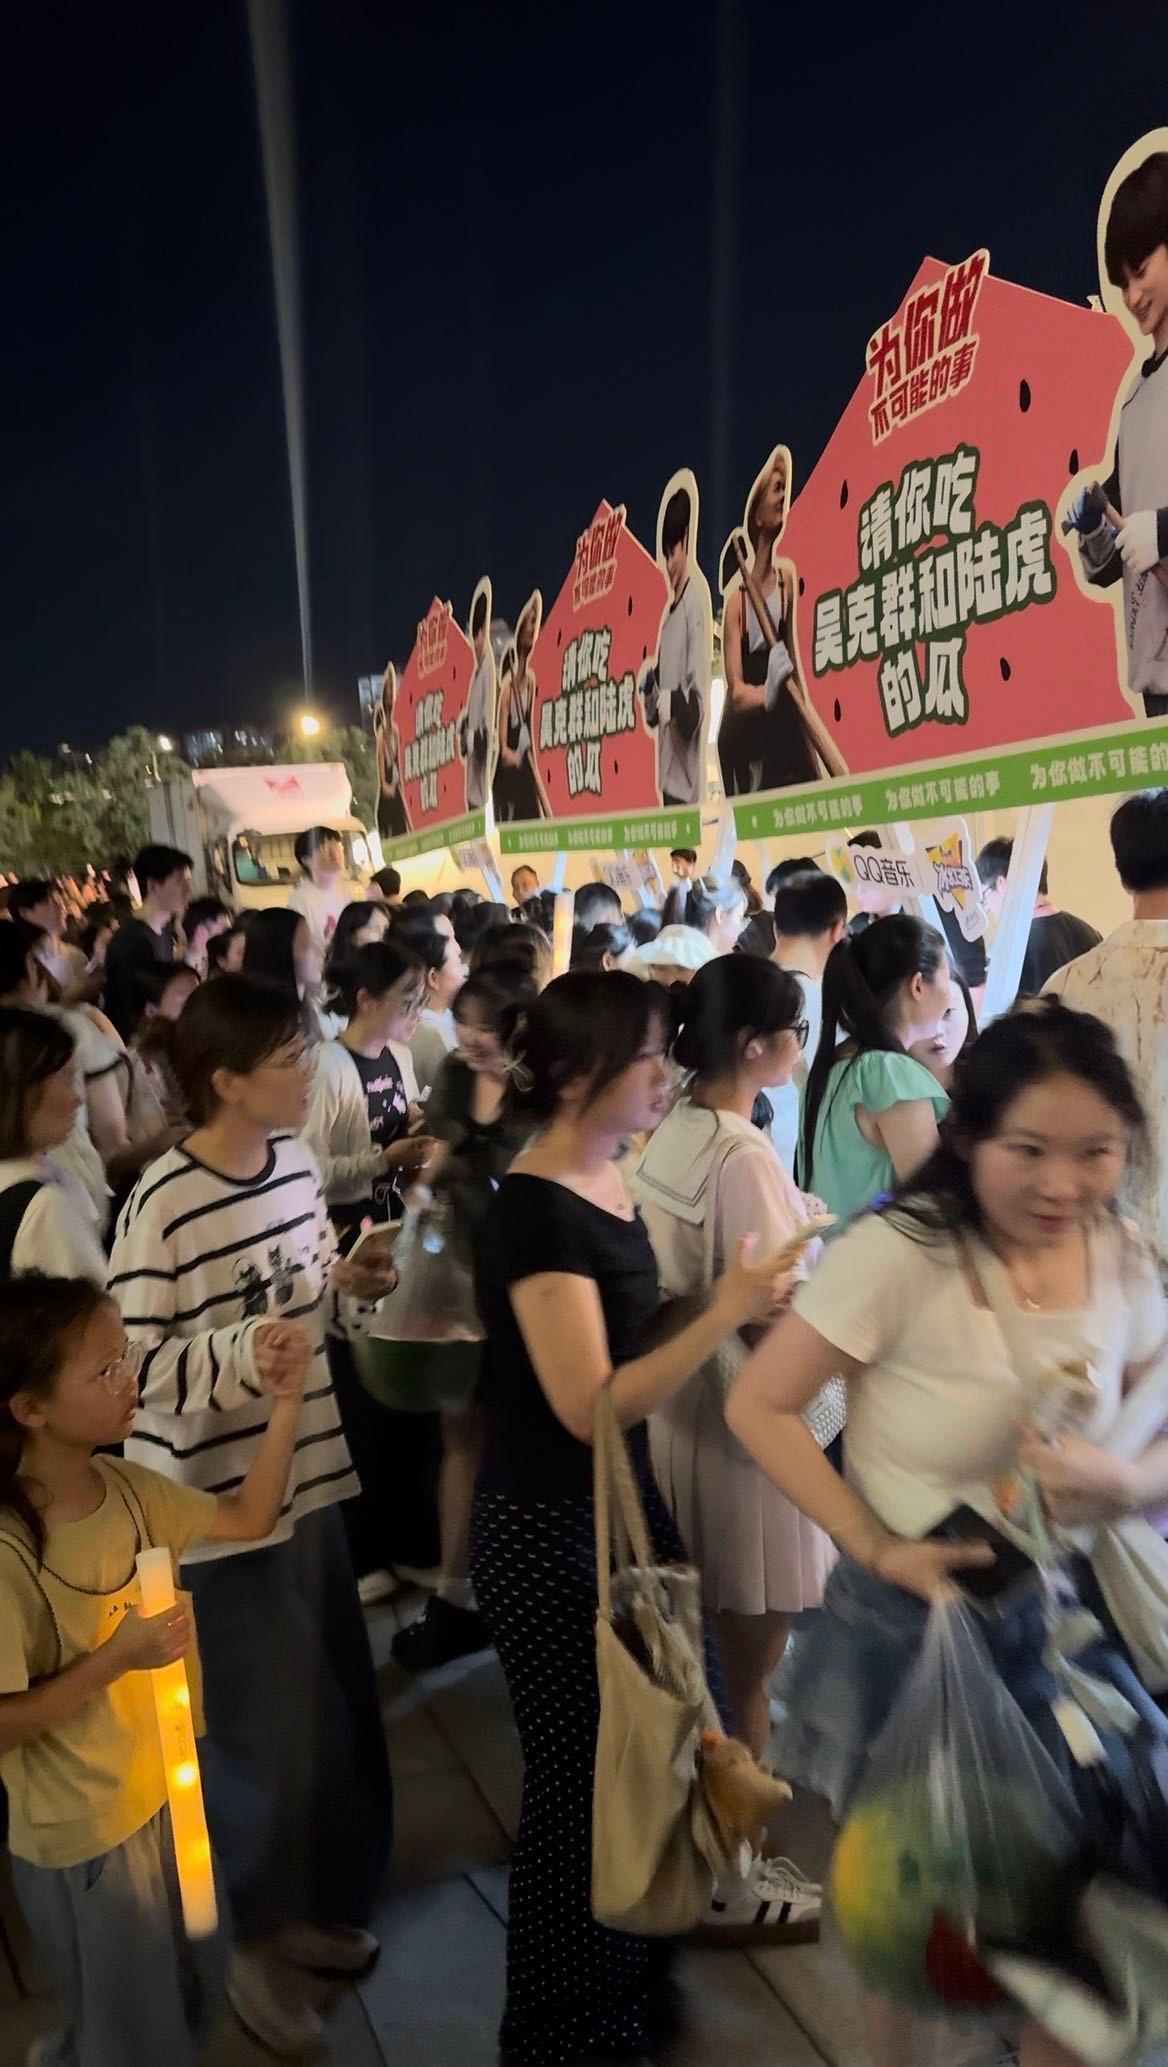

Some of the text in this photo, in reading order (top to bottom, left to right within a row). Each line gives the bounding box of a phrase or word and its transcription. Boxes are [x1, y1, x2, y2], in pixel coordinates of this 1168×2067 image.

[869, 255, 985, 398] 为你做
[869, 343, 975, 440] 不可能的事
[860, 451, 976, 570] 请你吃
[815, 508, 1051, 671] 吴克群和陆虎
[881, 638, 964, 732] 的瓜
[885, 771, 1000, 812] 为你做不可能的事
[853, 854, 915, 888] QQ音乐
